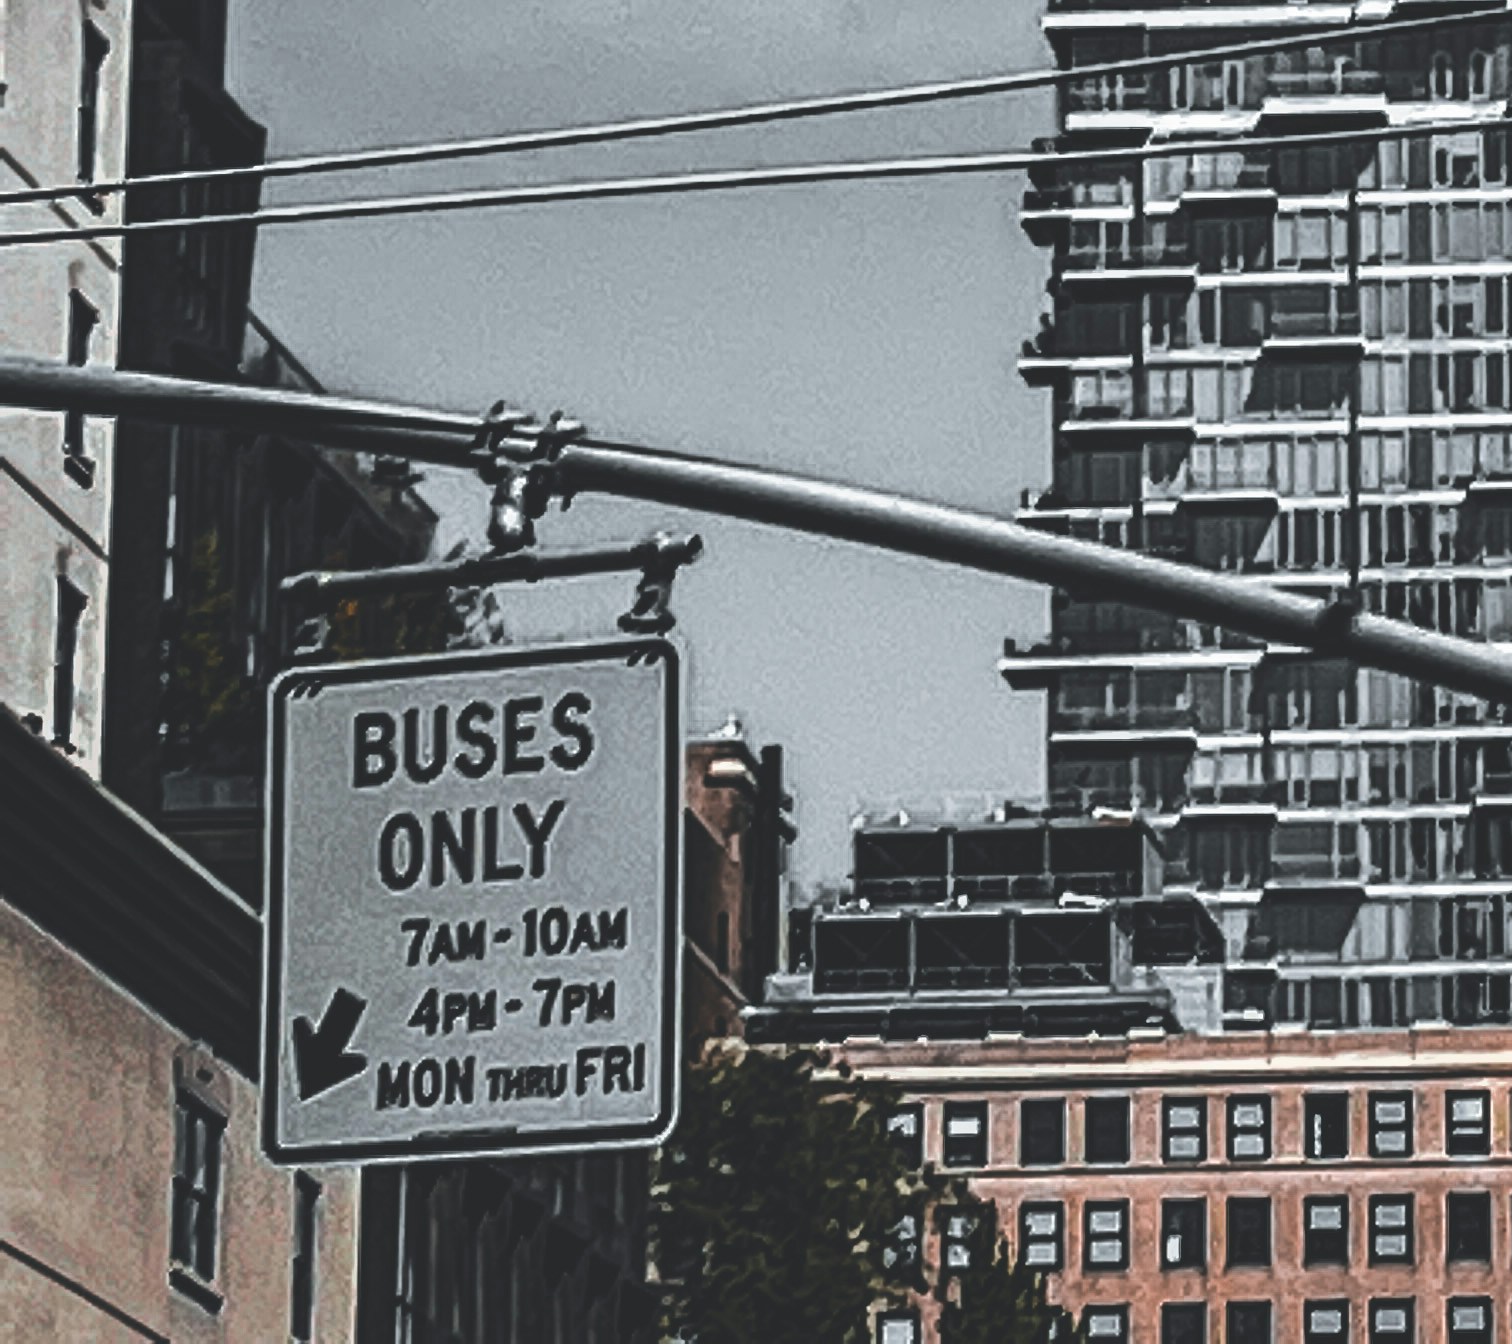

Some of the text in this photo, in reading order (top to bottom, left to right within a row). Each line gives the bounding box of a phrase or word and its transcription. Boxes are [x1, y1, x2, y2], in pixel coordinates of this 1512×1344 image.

[354, 692, 593, 788] BUSES
[378, 800, 566, 890] ONLY
[376, 1043, 646, 1110] MON THRU FRI
